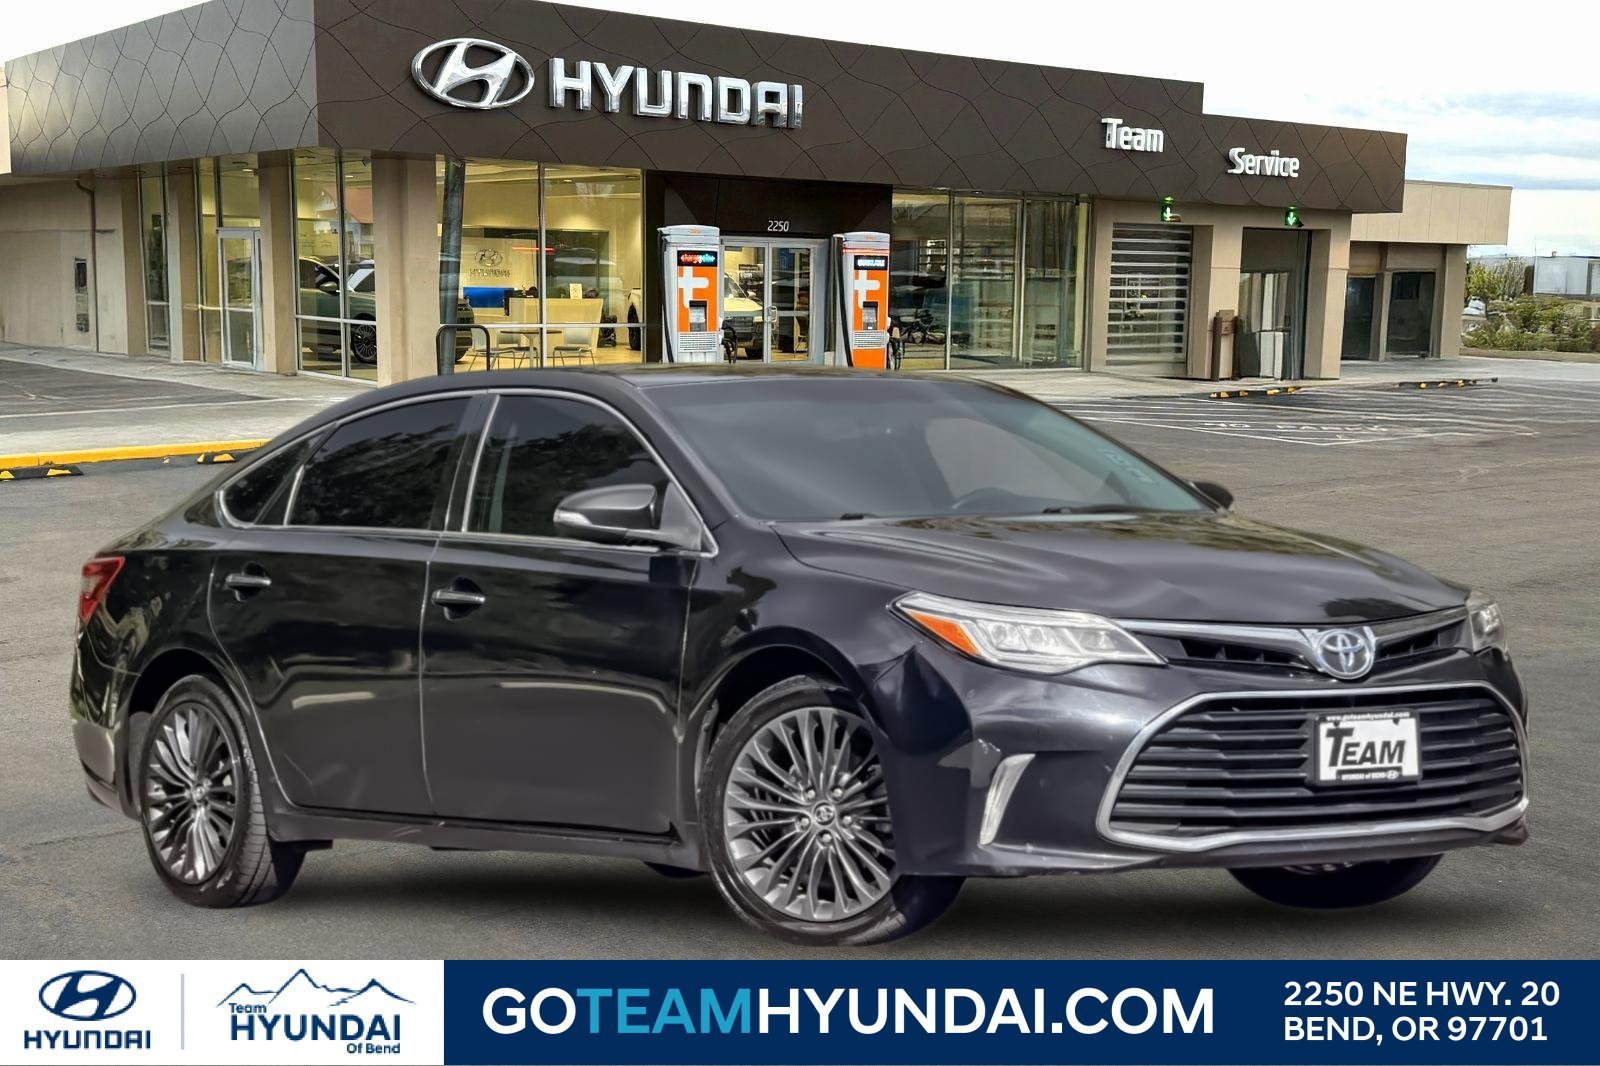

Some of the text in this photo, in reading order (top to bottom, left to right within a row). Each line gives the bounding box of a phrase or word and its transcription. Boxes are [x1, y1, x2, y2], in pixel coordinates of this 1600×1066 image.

[548, 57, 803, 129] HYUNDAI
[1101, 117, 1164, 152] Team
[1227, 147, 1300, 178] Service
[767, 220, 790, 232] 2250
[1325, 727, 1406, 767] TEAM
